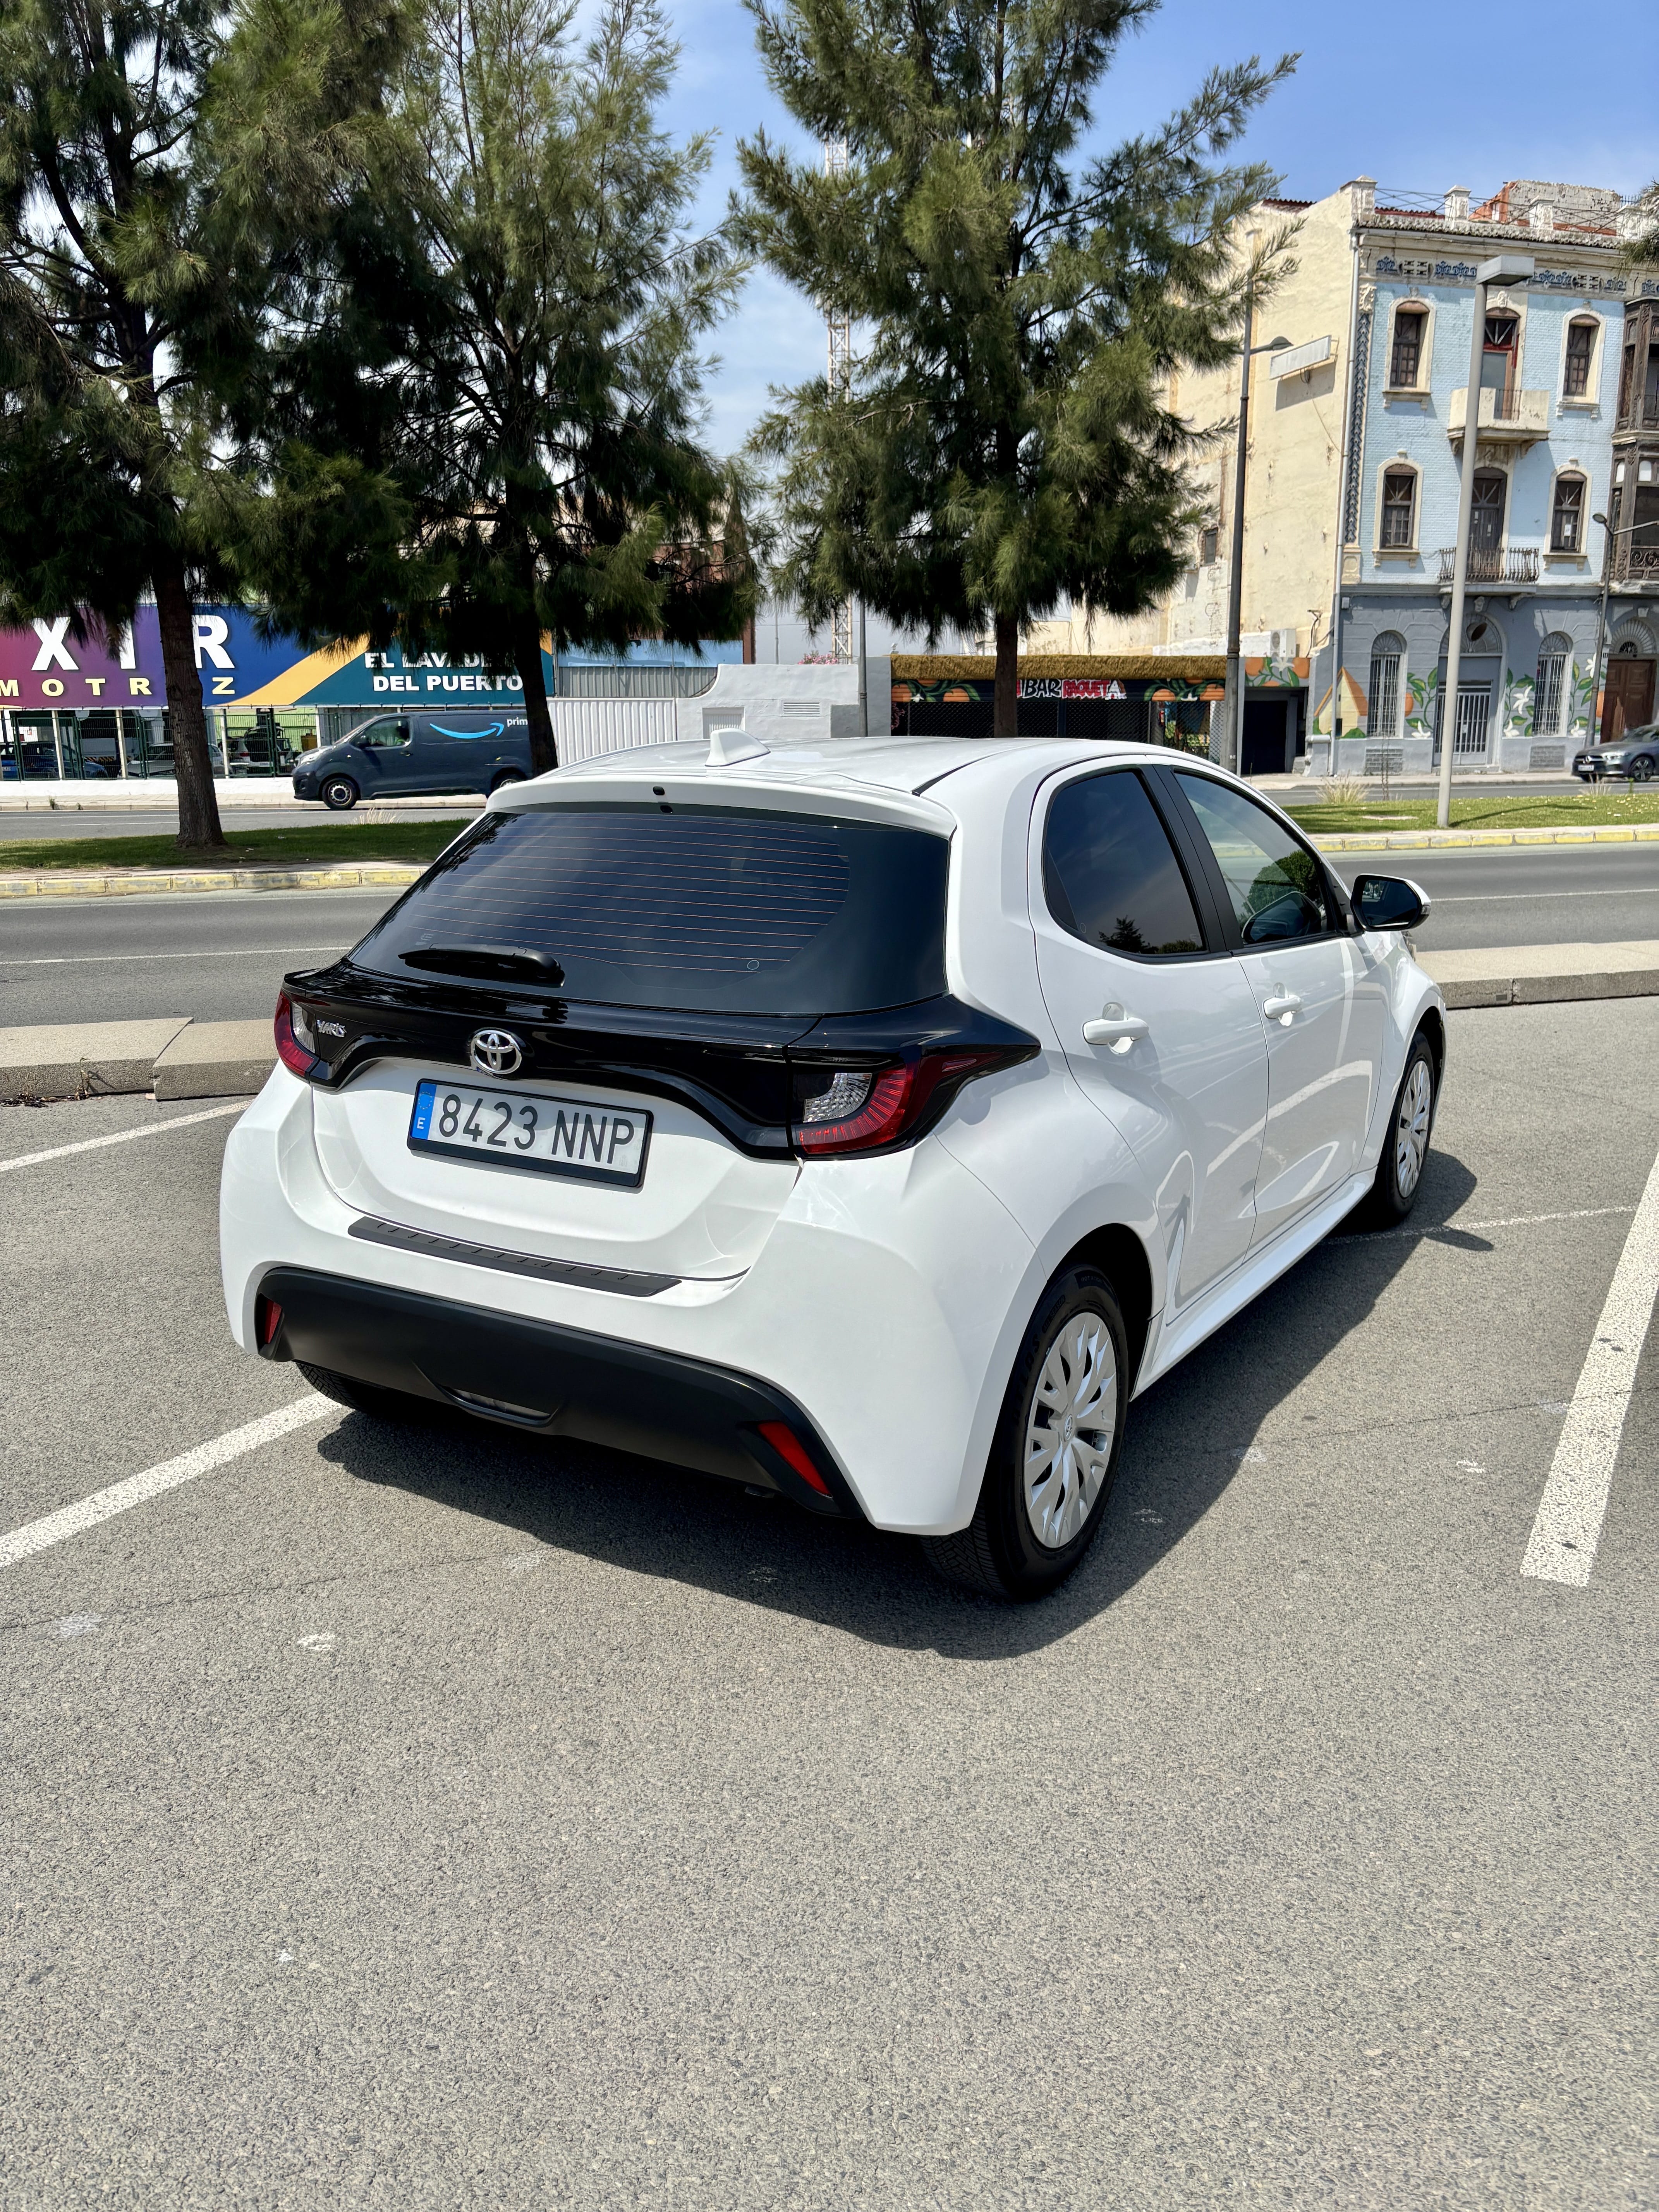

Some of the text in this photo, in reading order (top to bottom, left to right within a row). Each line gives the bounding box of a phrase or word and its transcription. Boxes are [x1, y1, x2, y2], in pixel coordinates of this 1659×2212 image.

[365, 653, 394, 668] EL
[0, 677, 235, 696] MOTRZ
[373, 675, 523, 691] DEL PUERTO
[507, 717, 528, 727] prim
[416, 1117, 426, 1130] E
[439, 1094, 635, 1164] 8423 NNP
